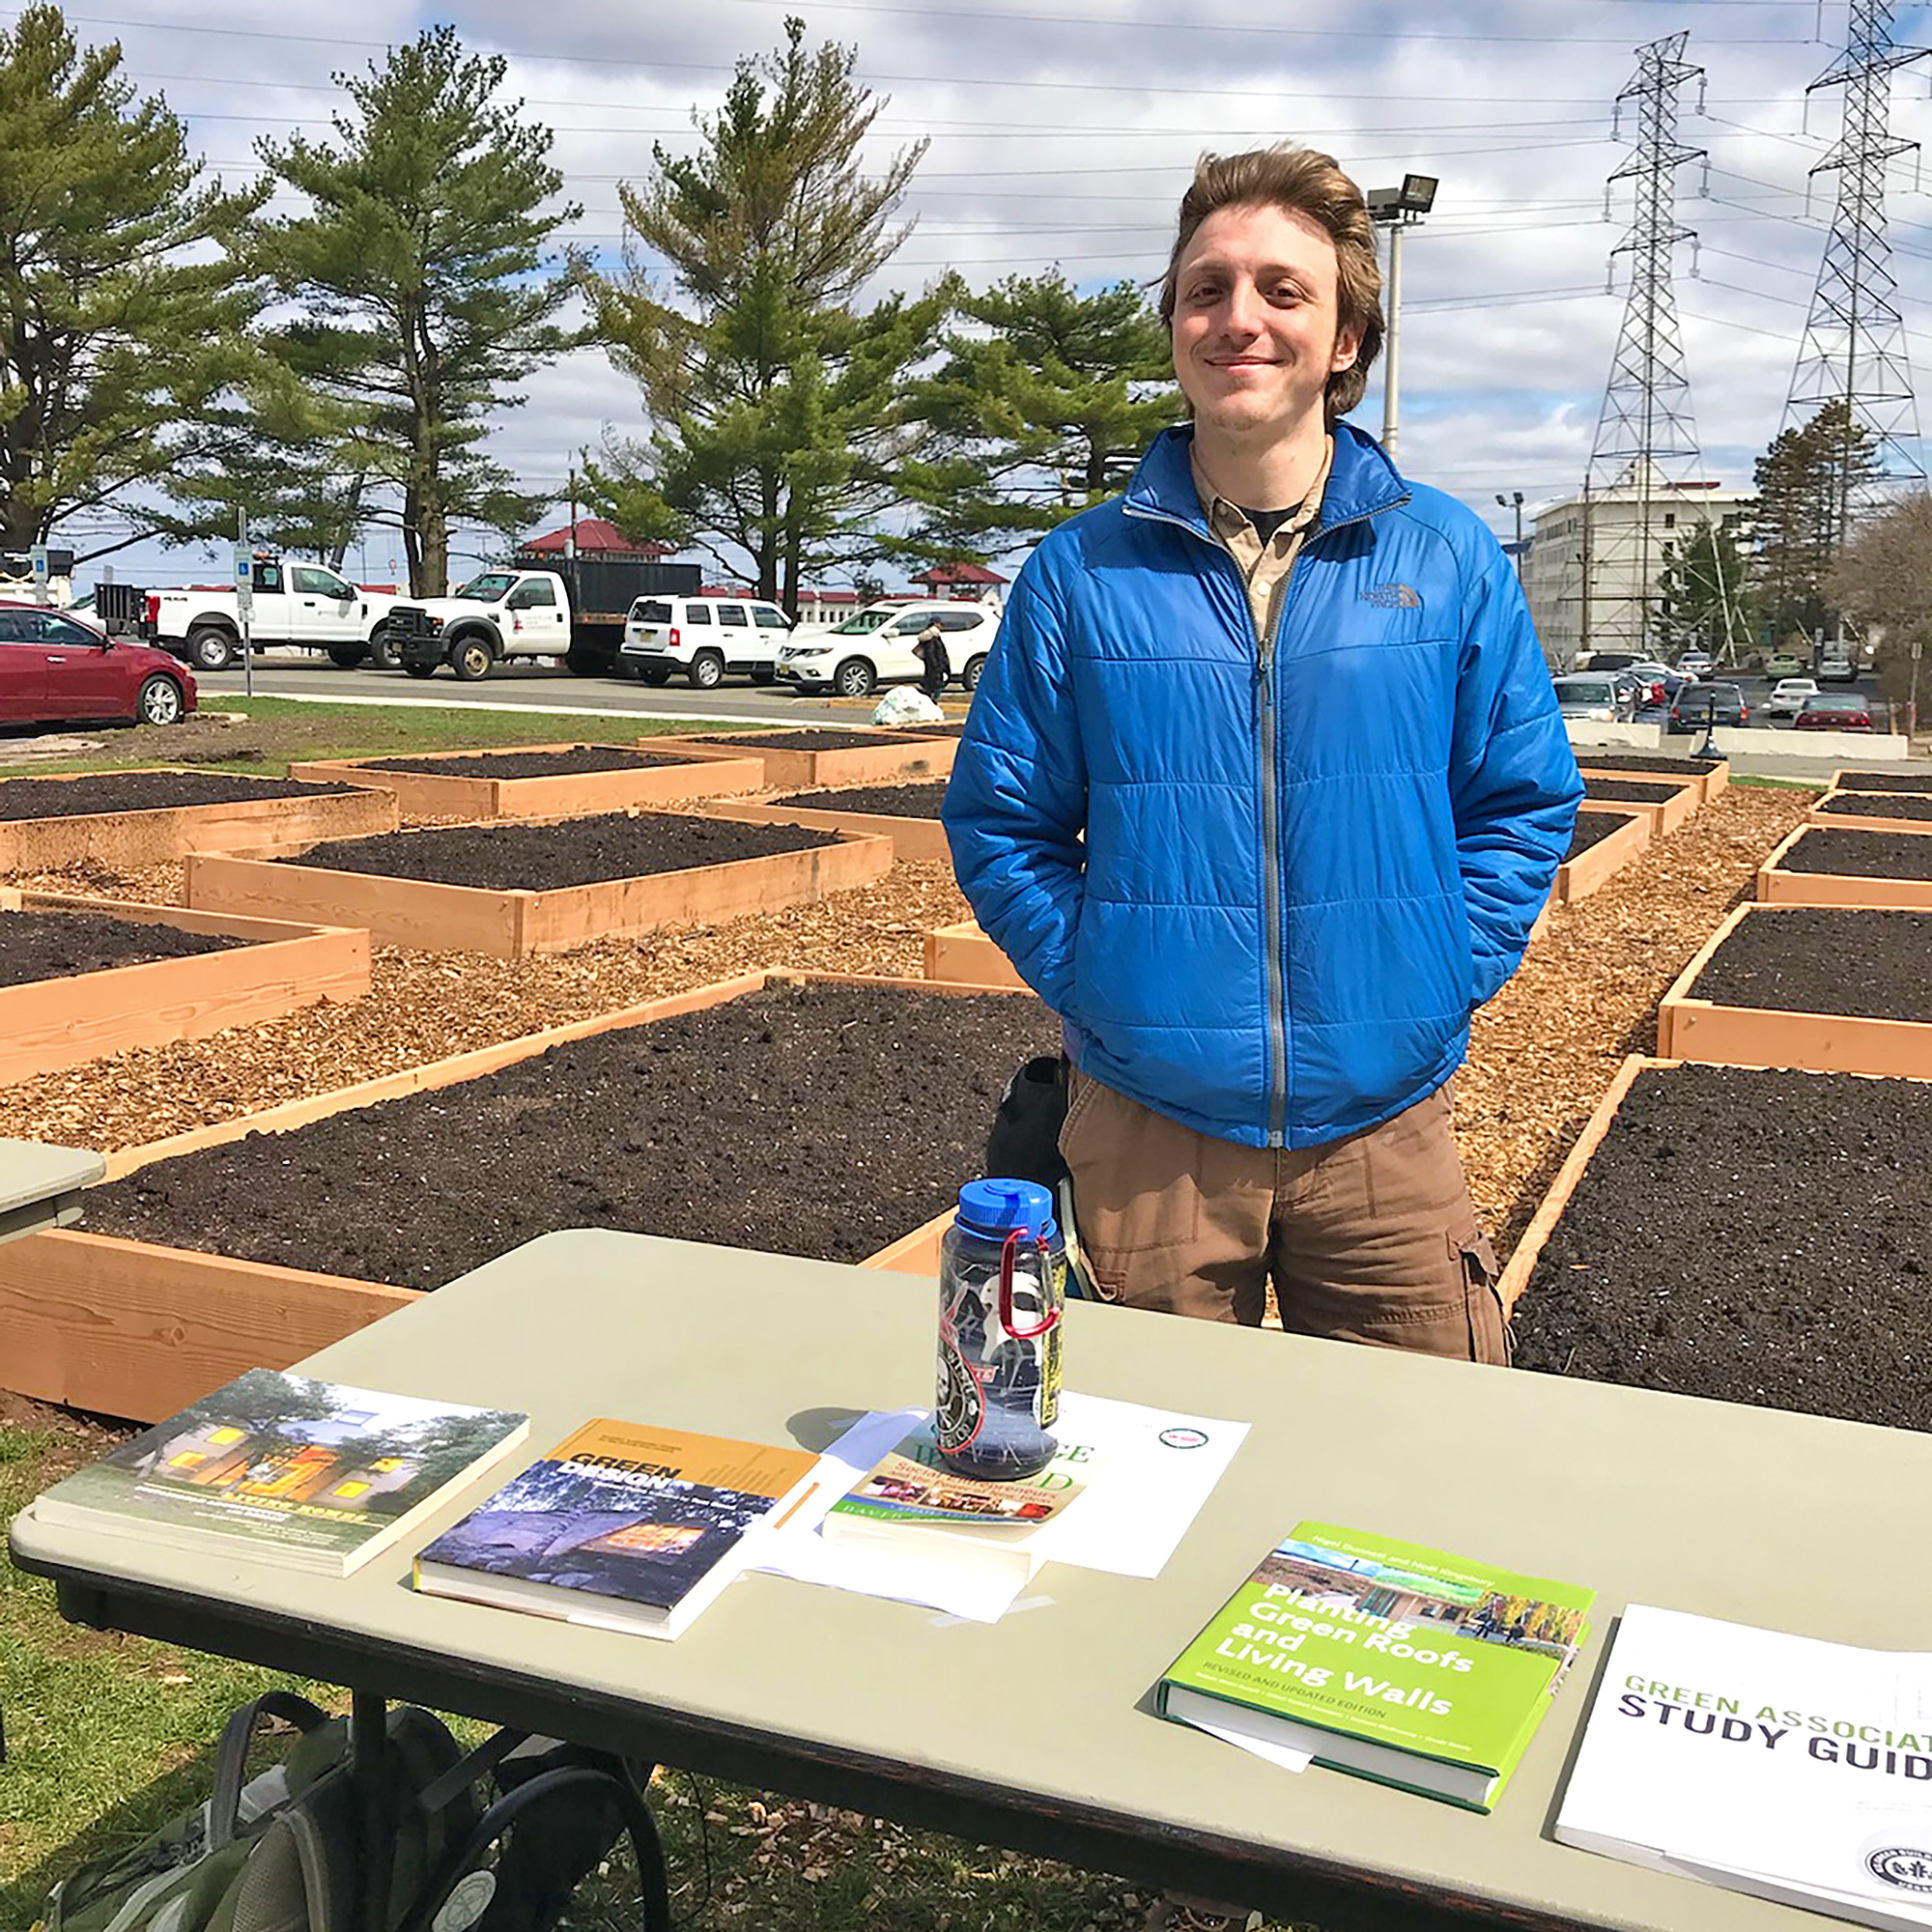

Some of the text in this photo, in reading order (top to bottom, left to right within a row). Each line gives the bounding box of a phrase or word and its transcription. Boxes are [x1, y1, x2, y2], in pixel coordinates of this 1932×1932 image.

[556, 1462, 673, 1489] DESIGN
[569, 1453, 682, 1478] GREEN
[895, 1462, 942, 1478] Social
[1312, 1534, 1341, 1548] Nigel
[1342, 1542, 1387, 1559] Dunnett
[1388, 1554, 1410, 1566] and
[1438, 1567, 1495, 1587] Kingsbury
[1232, 1622, 1306, 1652] and
[1249, 1602, 1474, 1673] Green Roofs
[1264, 1582, 1417, 1640] Planting
[1202, 1661, 1388, 1719] REVISED AND UPDATED EDITION
[1215, 1637, 1335, 1688] Living
[1344, 1671, 1453, 1716] Walls
[1625, 1674, 1739, 1715] GREEN
[1617, 1693, 1932, 1781] STUDY GUID
